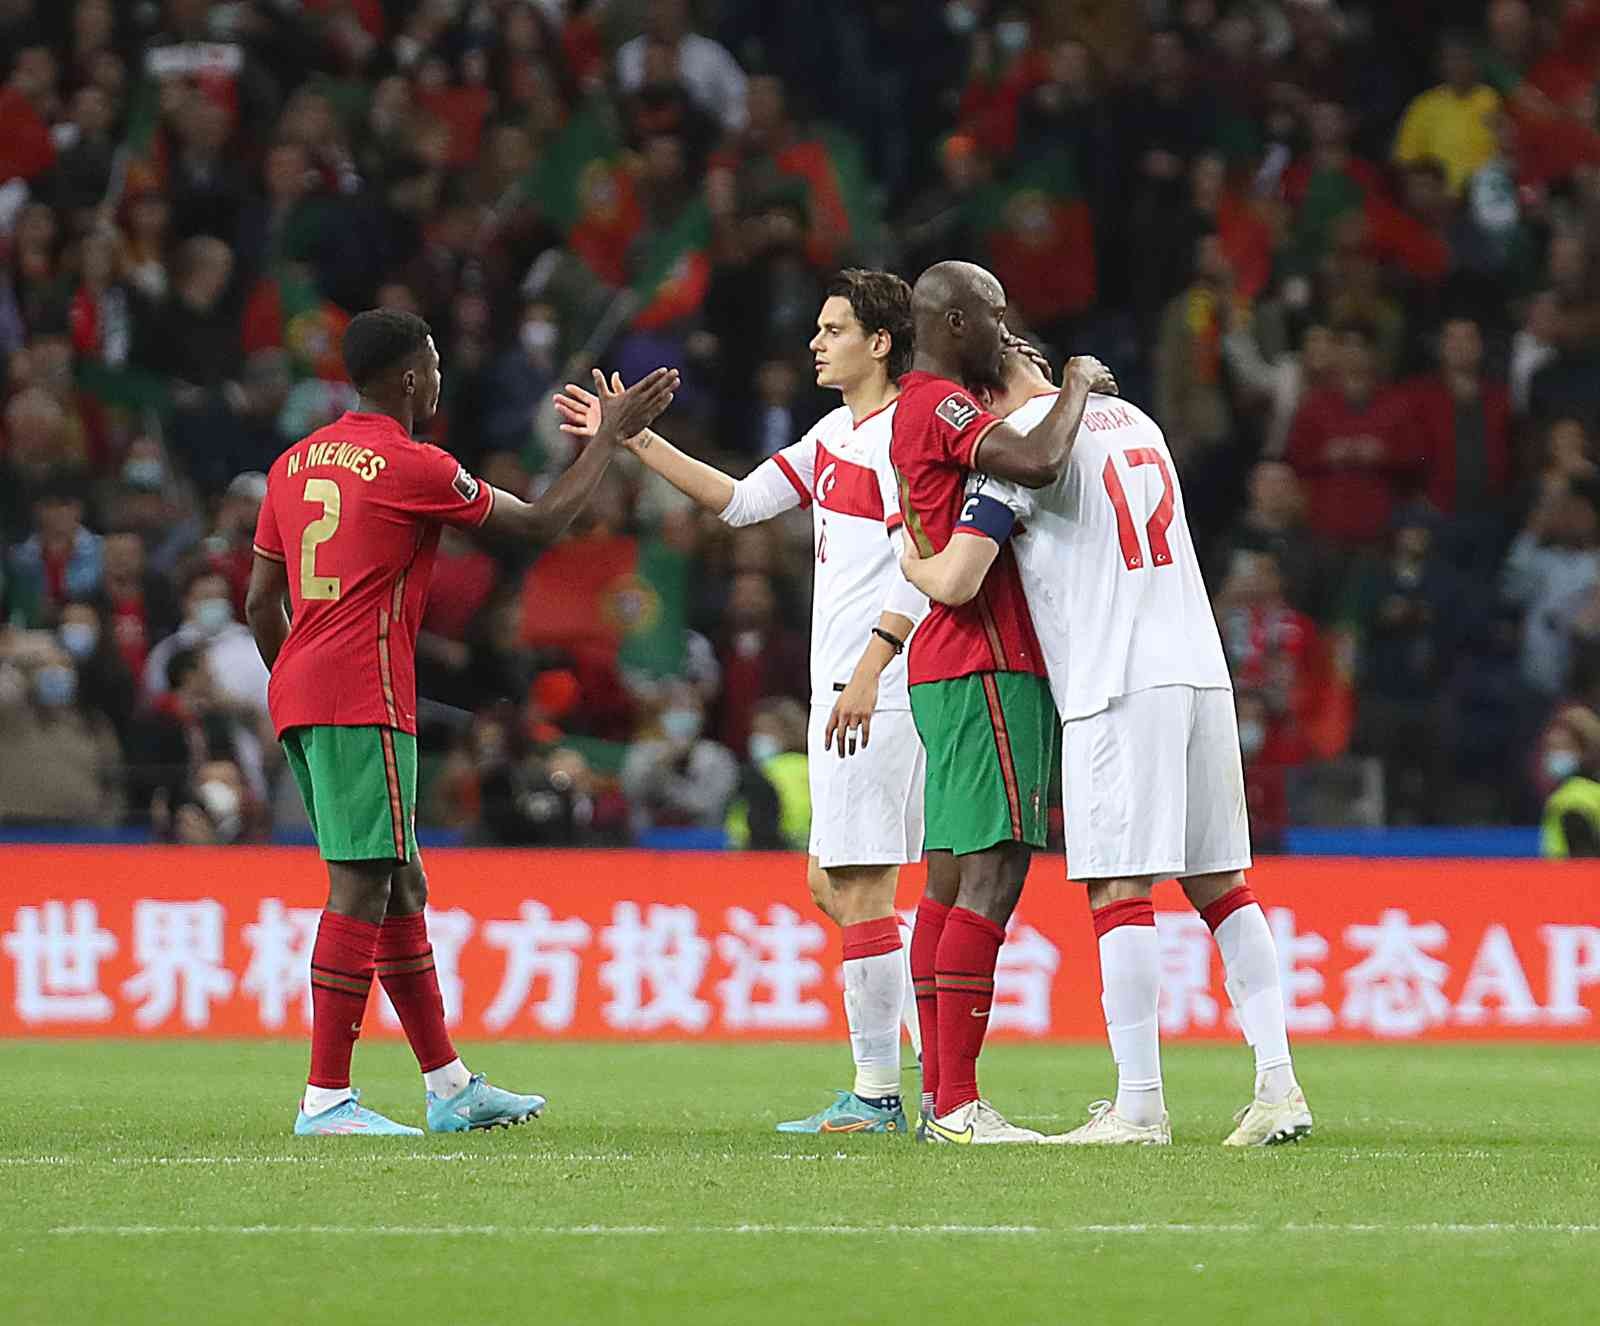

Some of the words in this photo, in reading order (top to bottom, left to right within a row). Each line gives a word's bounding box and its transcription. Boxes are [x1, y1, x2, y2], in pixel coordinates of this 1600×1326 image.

[287, 452, 304, 478] N.
[306, 442, 387, 481] MENDES
[1102, 448, 1174, 571] 17
[301, 478, 341, 600] 2
